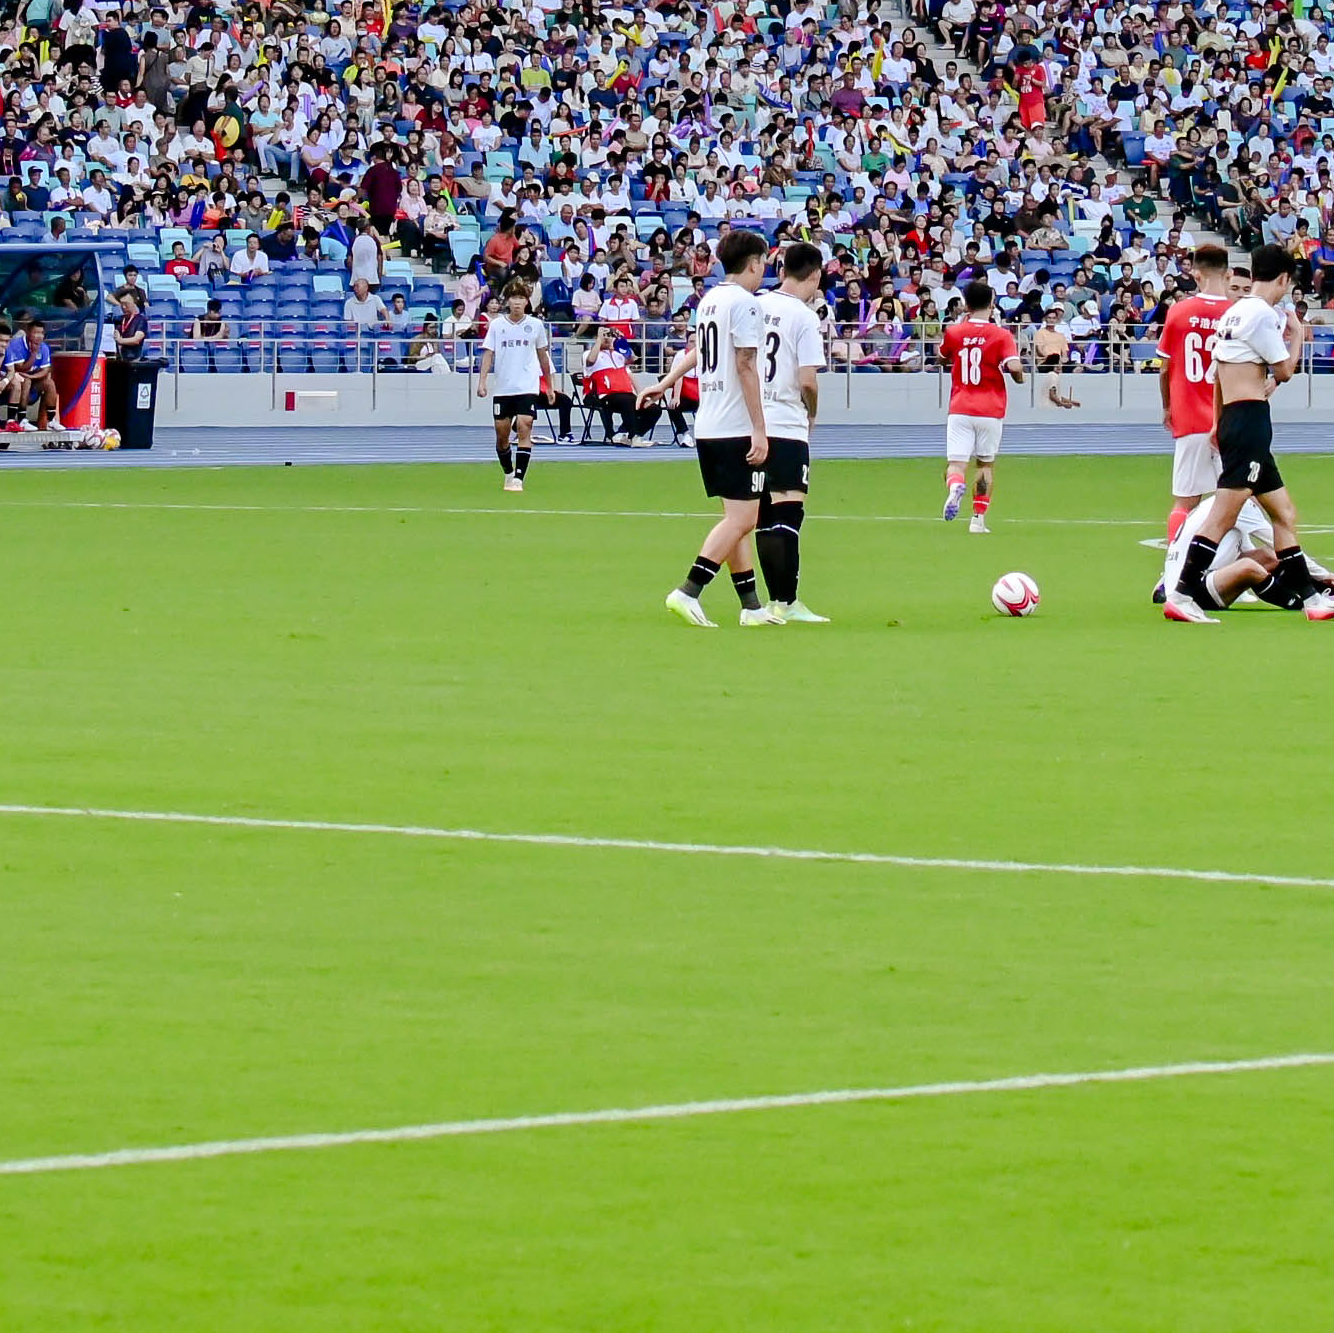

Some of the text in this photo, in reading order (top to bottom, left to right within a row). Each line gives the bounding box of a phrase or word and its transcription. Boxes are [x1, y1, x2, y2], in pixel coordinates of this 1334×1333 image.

[765, 332, 781, 383] 3
[958, 347, 982, 385] 18
[751, 471, 765, 492] 90
